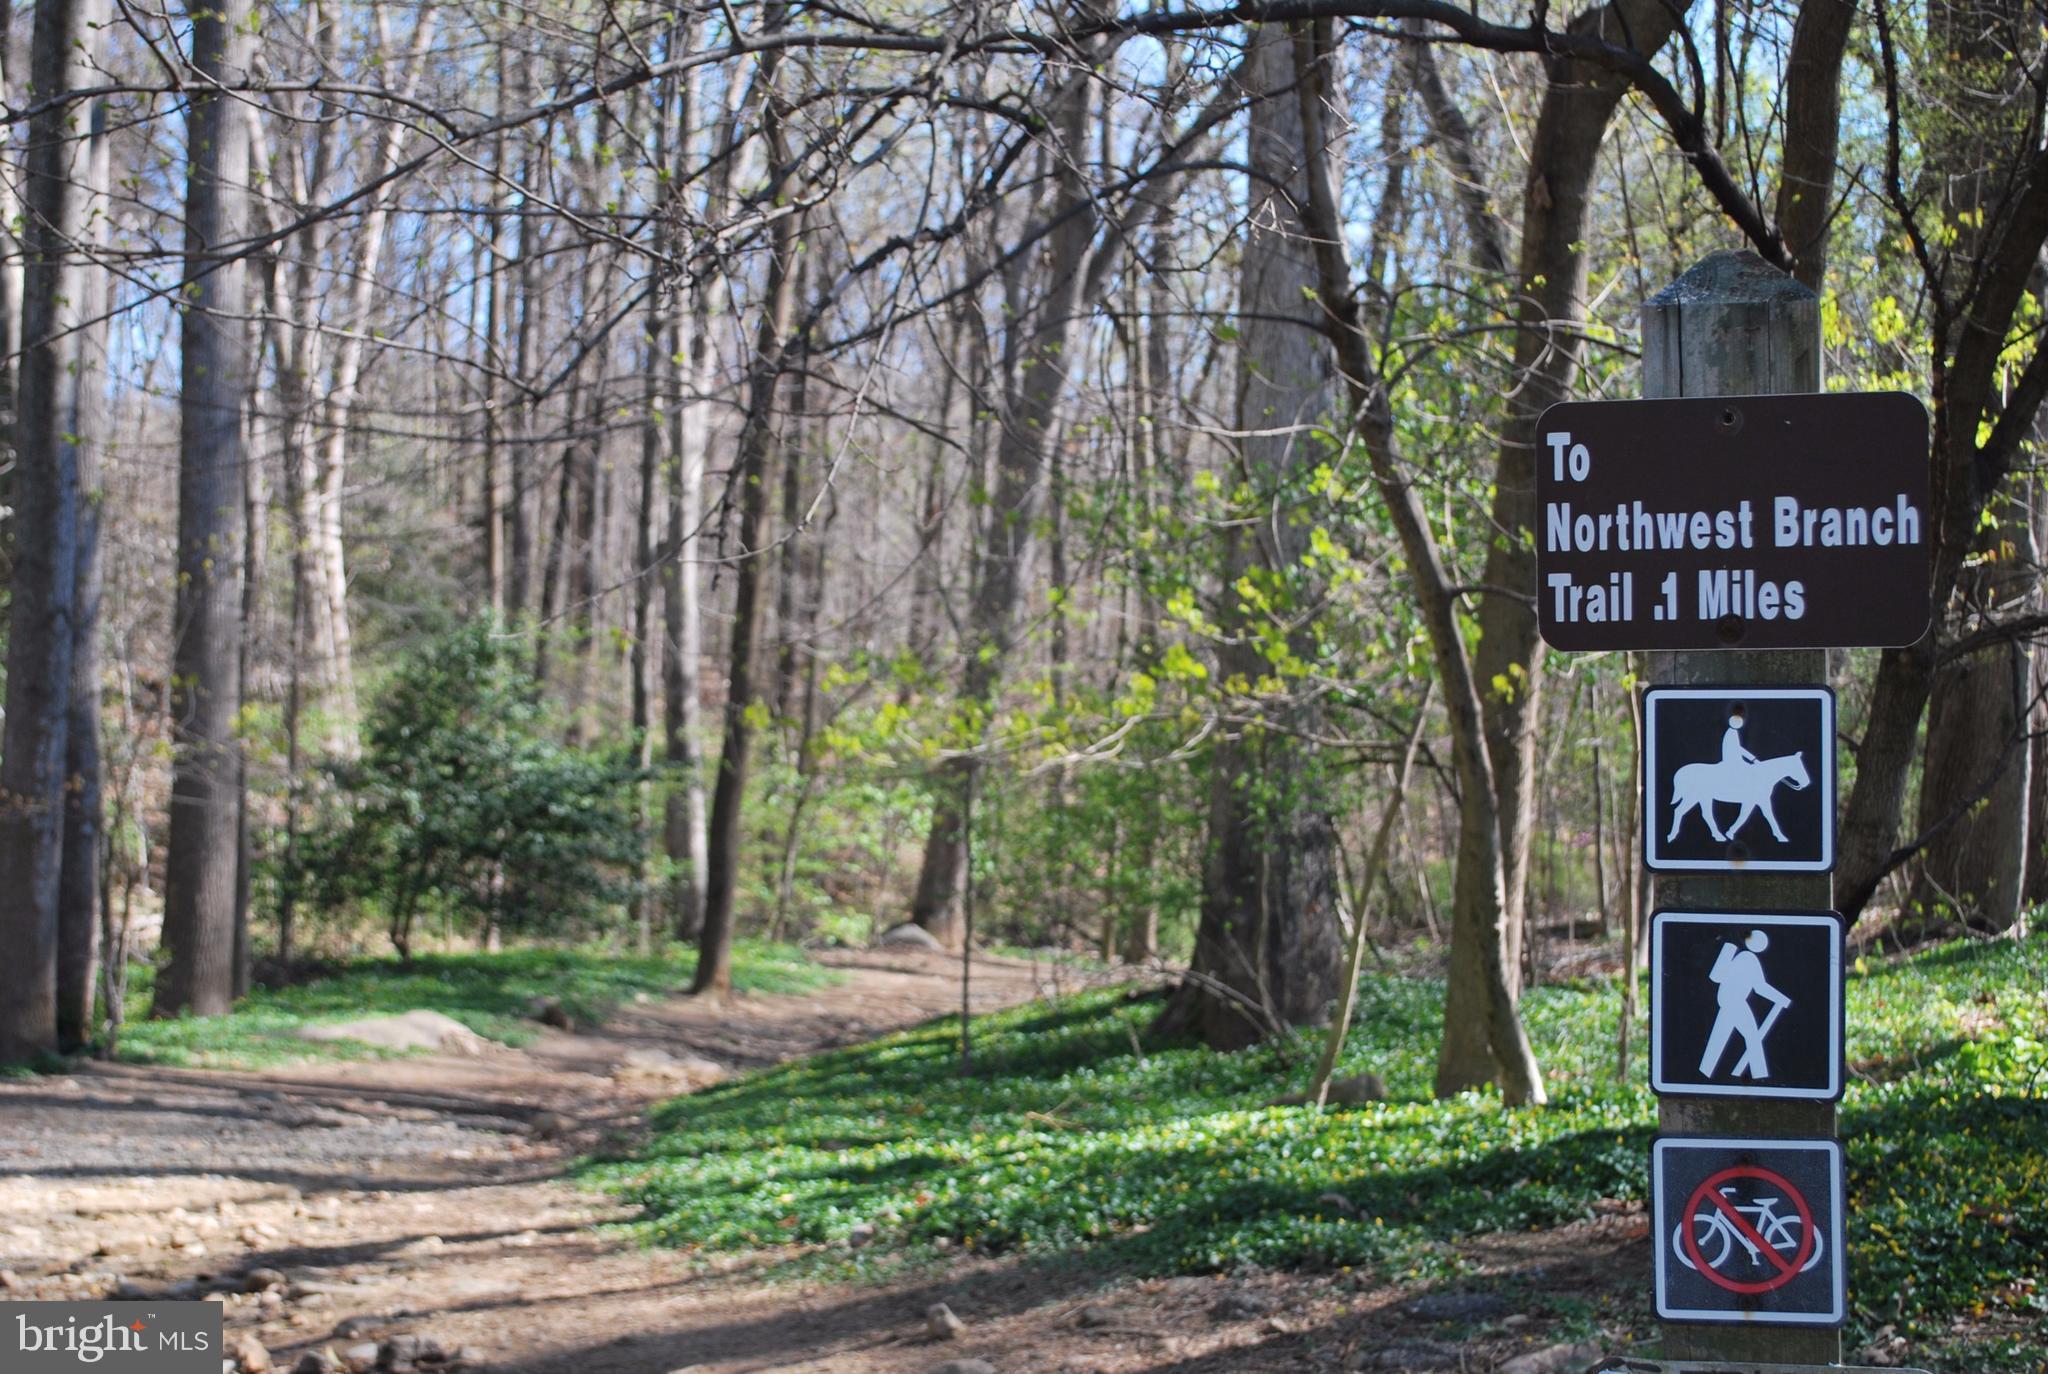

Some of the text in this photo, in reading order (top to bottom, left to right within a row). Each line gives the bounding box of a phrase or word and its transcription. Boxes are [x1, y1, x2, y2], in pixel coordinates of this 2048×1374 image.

[1547, 432, 1590, 482] To
[1547, 494, 1920, 552] Northwest Branch
[1547, 568, 1806, 623] Trail .1 Miles
